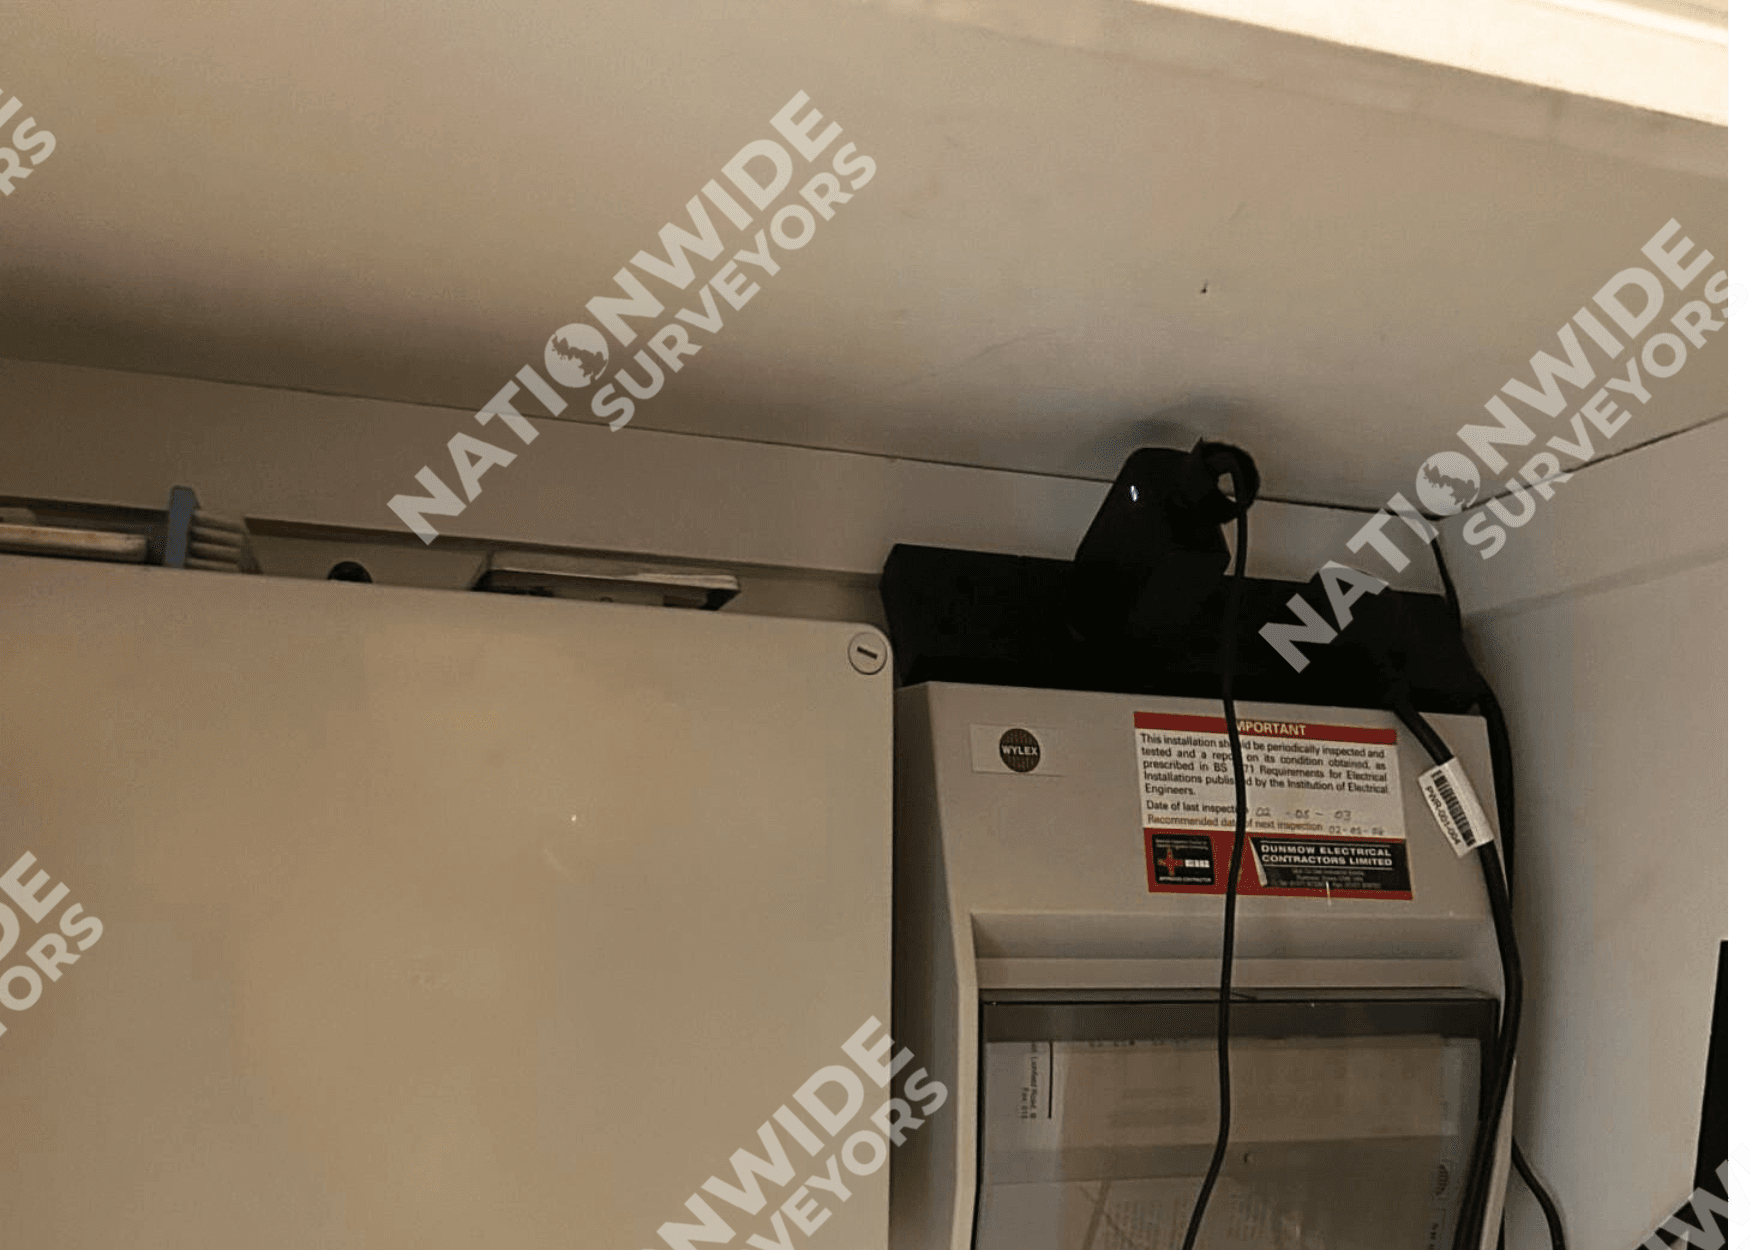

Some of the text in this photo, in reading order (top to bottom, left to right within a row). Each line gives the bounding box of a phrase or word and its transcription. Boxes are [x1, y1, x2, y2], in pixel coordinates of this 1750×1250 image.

[1236, 720, 1307, 736] MPORTANT
[1001, 745, 1038, 756] WYLEX
[1140, 732, 1385, 758] This installation shld be periodically inspected and
[1141, 747, 1172, 757] tested
[1177, 749, 1196, 758] and
[1201, 751, 1207, 759] a
[1212, 752, 1232, 761] repo
[1246, 754, 1259, 762] on
[1264, 754, 1275, 763] its
[1280, 755, 1323, 766] condition
[1143, 760, 1195, 771] prescribed
[1200, 762, 1209, 771] in
[1213, 762, 1228, 772] BS
[1260, 765, 1325, 778] Requirements
[1329, 769, 1342, 779] for
[1346, 770, 1387, 782] Electrical
[1144, 771, 1388, 794] Installations publisd by the Institution of Electrical
[1146, 800, 1248, 814] Date of last inspect
[1221, 818, 1236, 827] dat
[1260, 844, 1392, 857] DUNMOW ELECTRICAL
[1261, 854, 1393, 867] CONTRACTORS LIMITED
